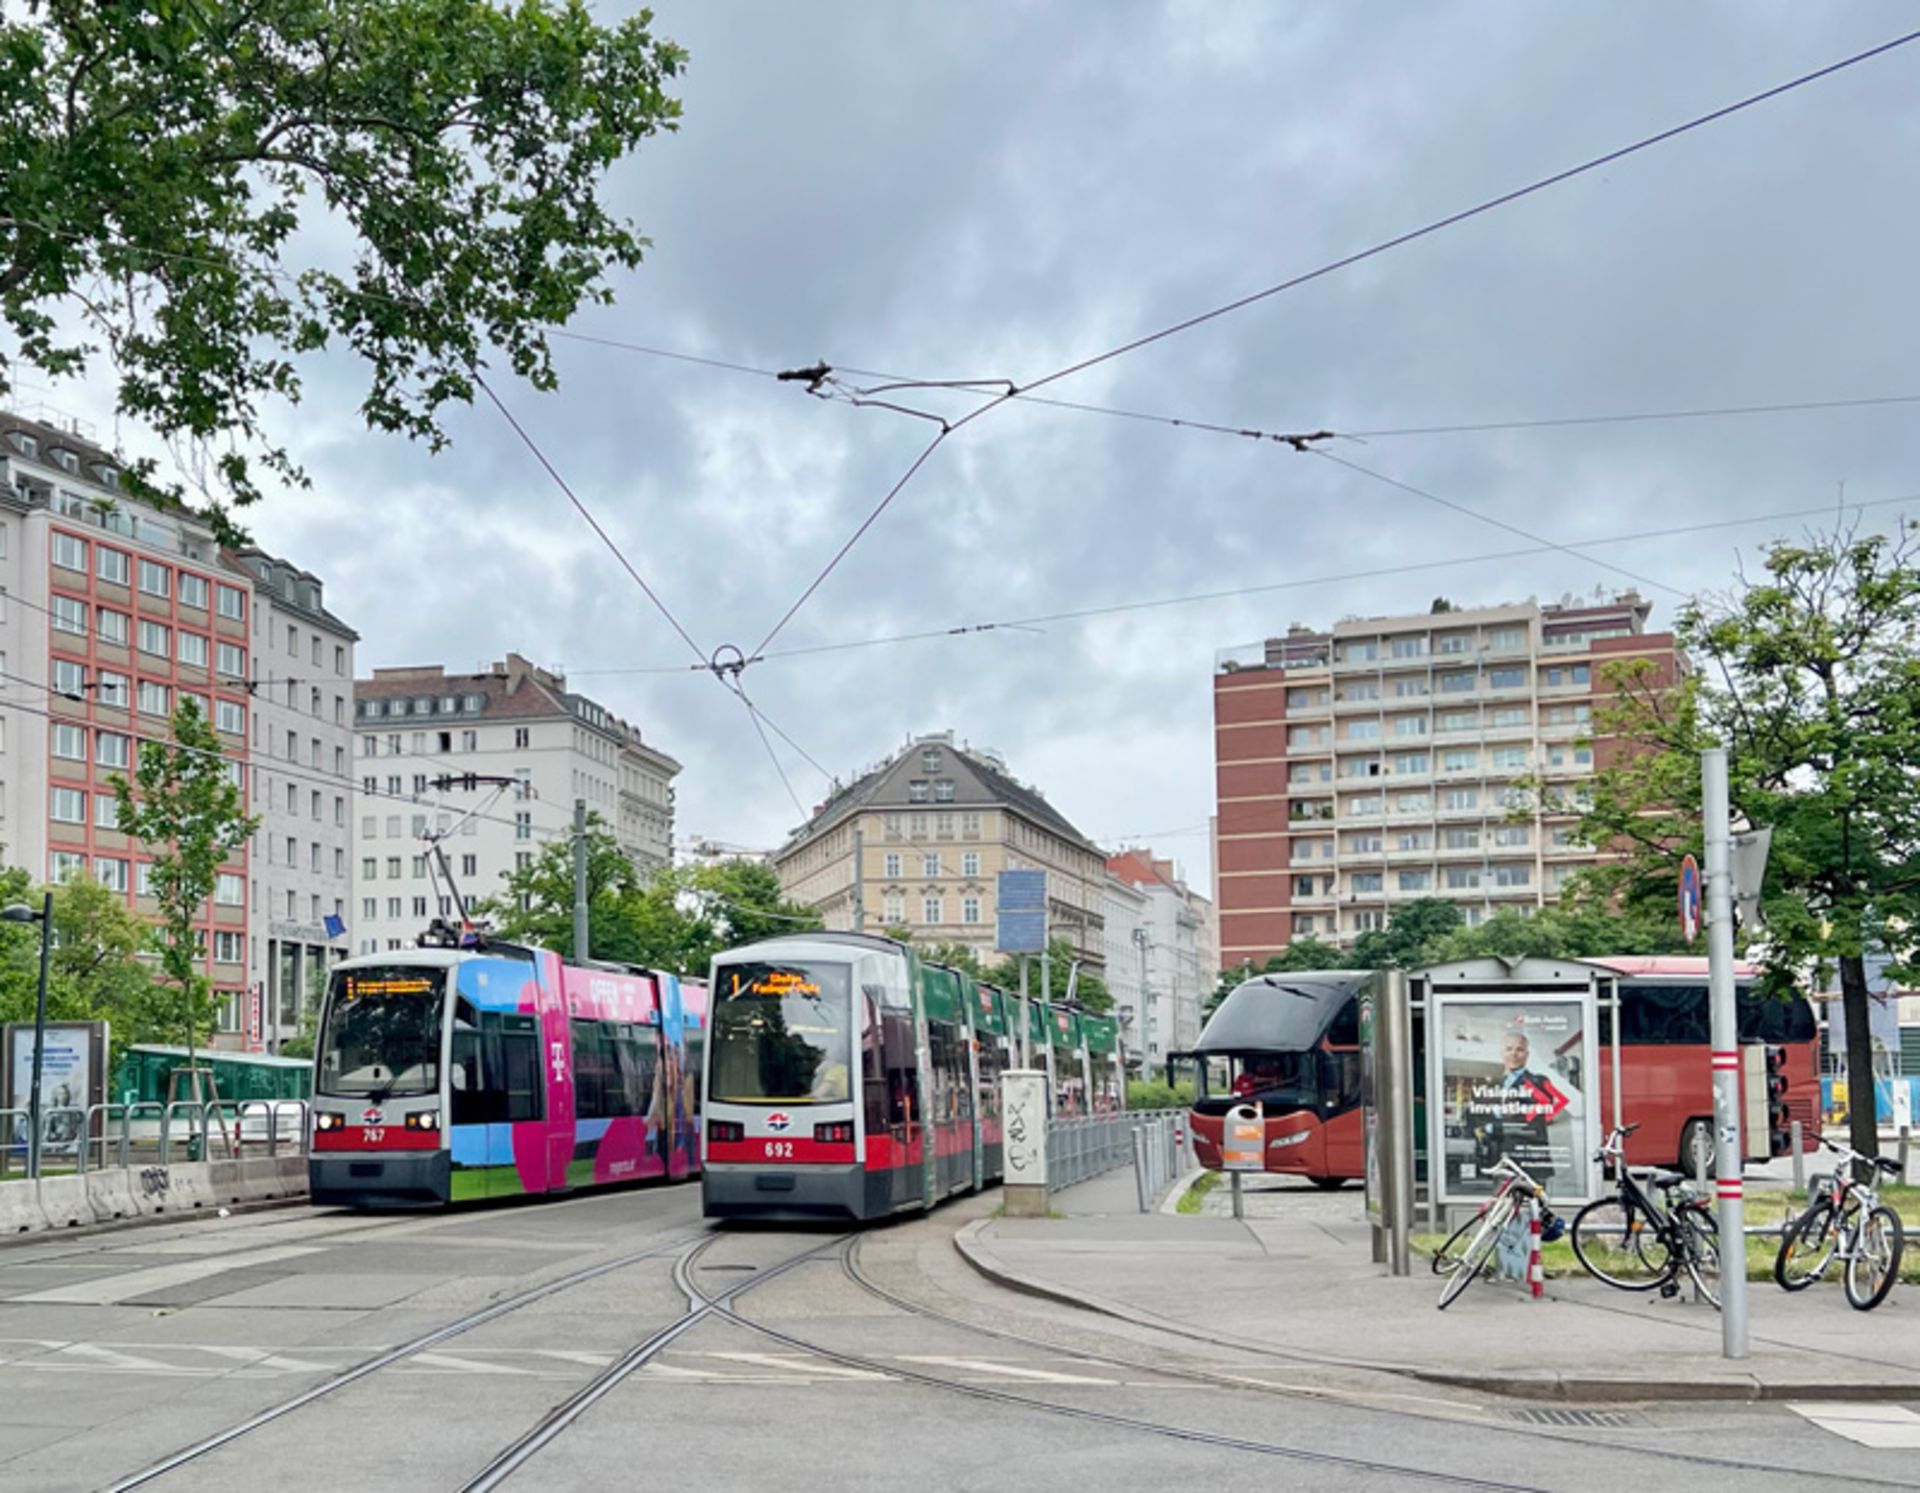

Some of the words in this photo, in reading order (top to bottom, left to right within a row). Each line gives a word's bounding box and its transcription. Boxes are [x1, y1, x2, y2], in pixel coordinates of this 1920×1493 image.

[731, 974, 740, 995] 1
[1472, 1083, 1534, 1098] Visionär
[362, 1127, 385, 1142] 767
[764, 1141, 794, 1158] 692
